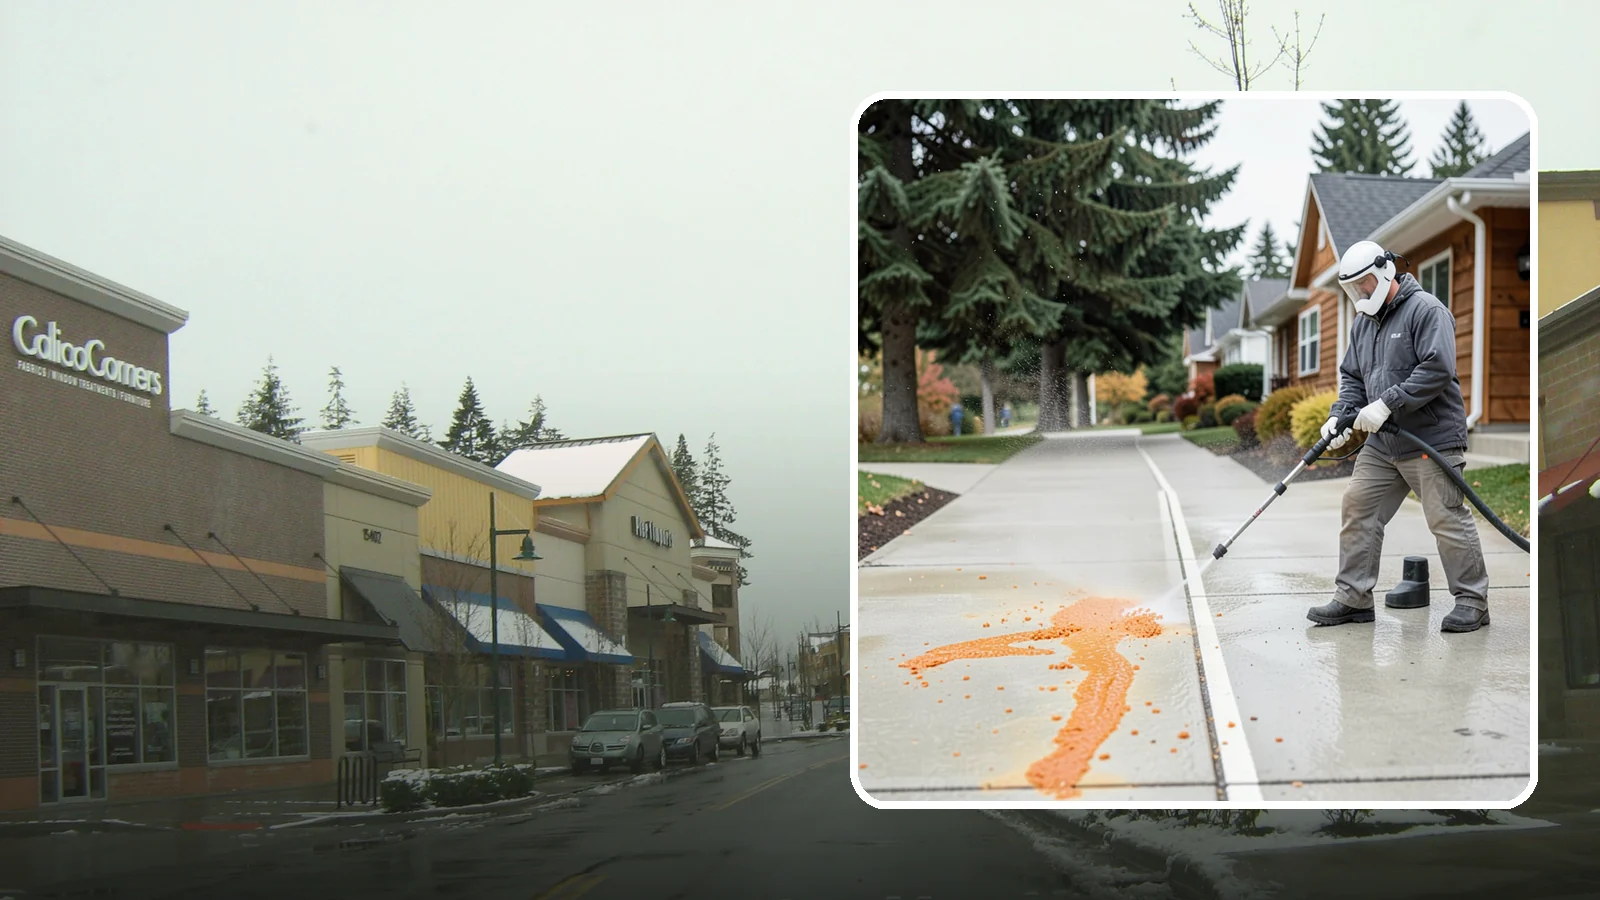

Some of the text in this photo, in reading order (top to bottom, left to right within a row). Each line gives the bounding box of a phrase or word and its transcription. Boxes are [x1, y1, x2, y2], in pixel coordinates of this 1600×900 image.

[16, 360, 47, 377] FABRICS
[51, 370, 78, 386] WINDOW
[79, 379, 117, 398] TREATMENTS
